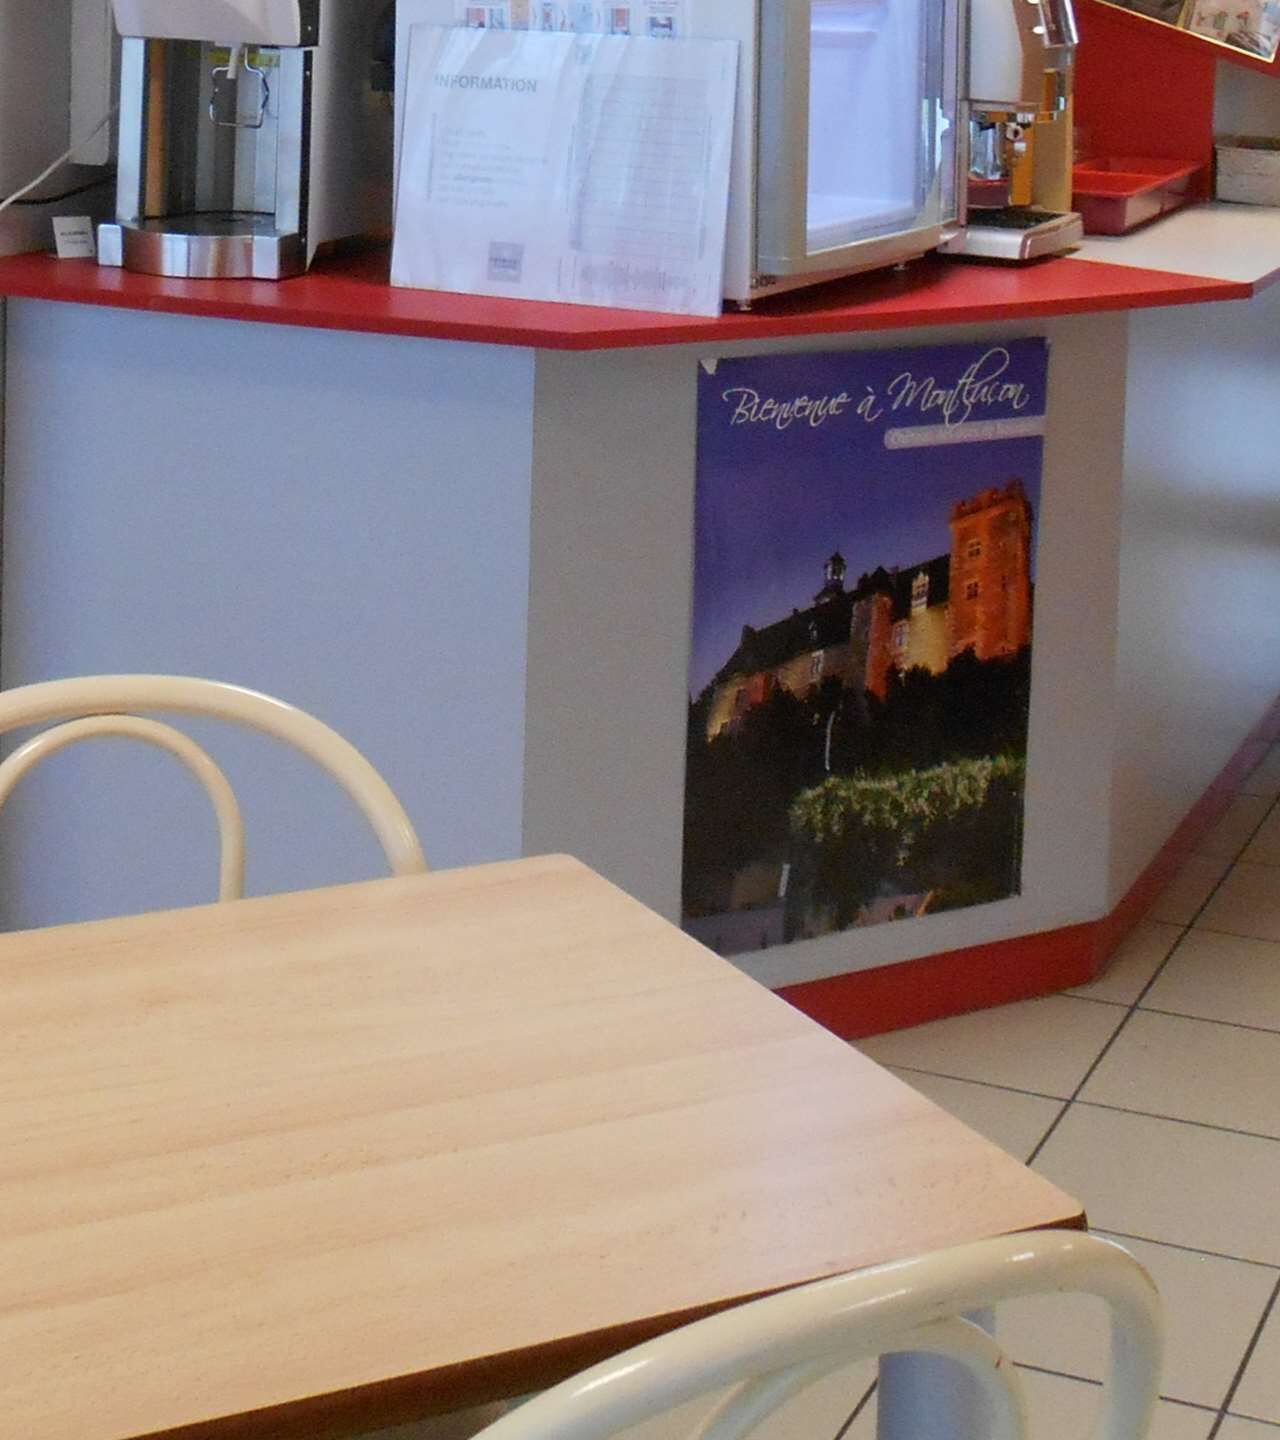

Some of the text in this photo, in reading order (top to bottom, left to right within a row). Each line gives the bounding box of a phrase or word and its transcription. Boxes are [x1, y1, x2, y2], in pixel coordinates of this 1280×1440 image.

[435, 74, 538, 93] INFORMATION
[722, 347, 1030, 430] Bienvenue à Montluçon
